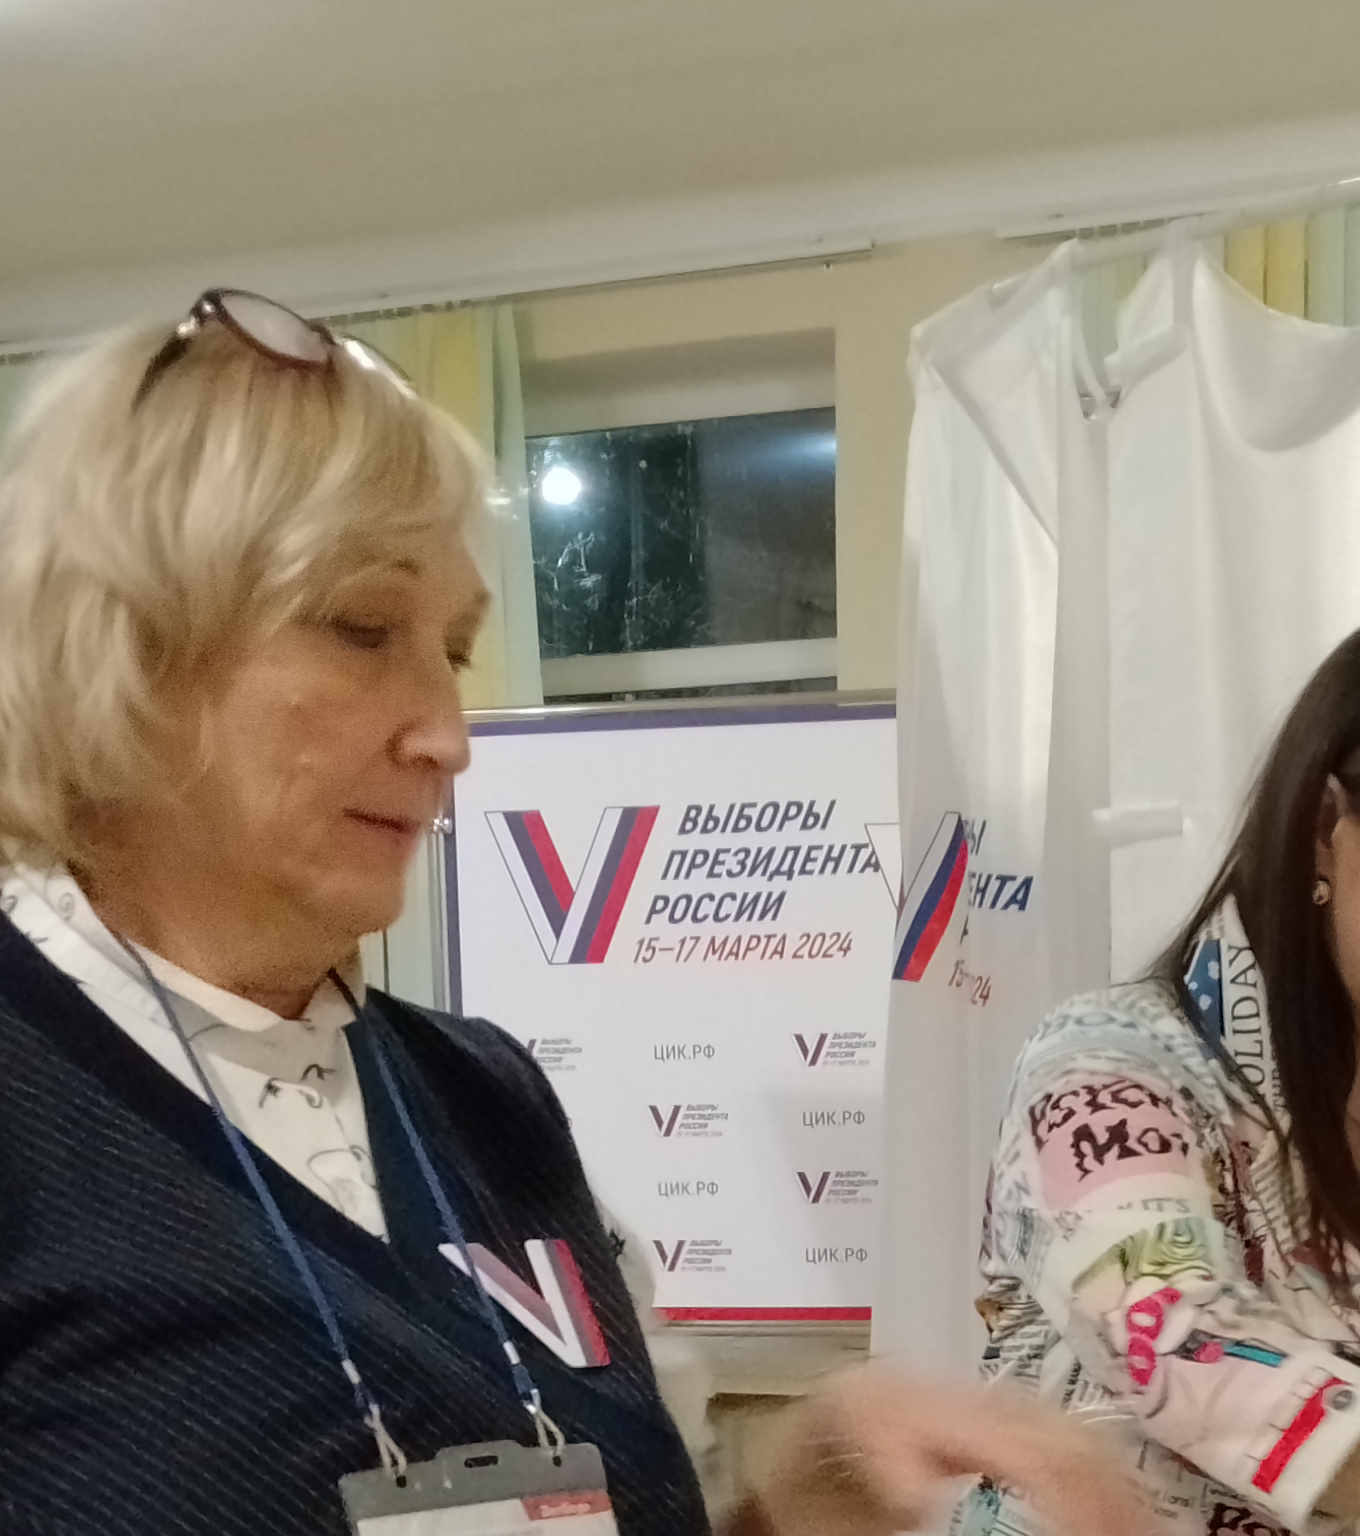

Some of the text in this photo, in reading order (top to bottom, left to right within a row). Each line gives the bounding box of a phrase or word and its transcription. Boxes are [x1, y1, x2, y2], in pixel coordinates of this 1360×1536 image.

[677, 799, 837, 835] ВЫБОРЫ
[661, 842, 882, 882] ПРЕЗИДЕНТА
[644, 891, 787, 925] РОССИИ
[703, 934, 786, 962] МАРТА
[791, 931, 853, 960] 2024
[1227, 943, 1267, 1090] OLIDAY
[653, 1043, 716, 1062] ЦИК.РФ
[802, 1110, 866, 1129] ЦИК.РФ
[658, 1181, 719, 1198] ЦИК.РФ
[805, 1247, 868, 1265] ЦИК.РФ
